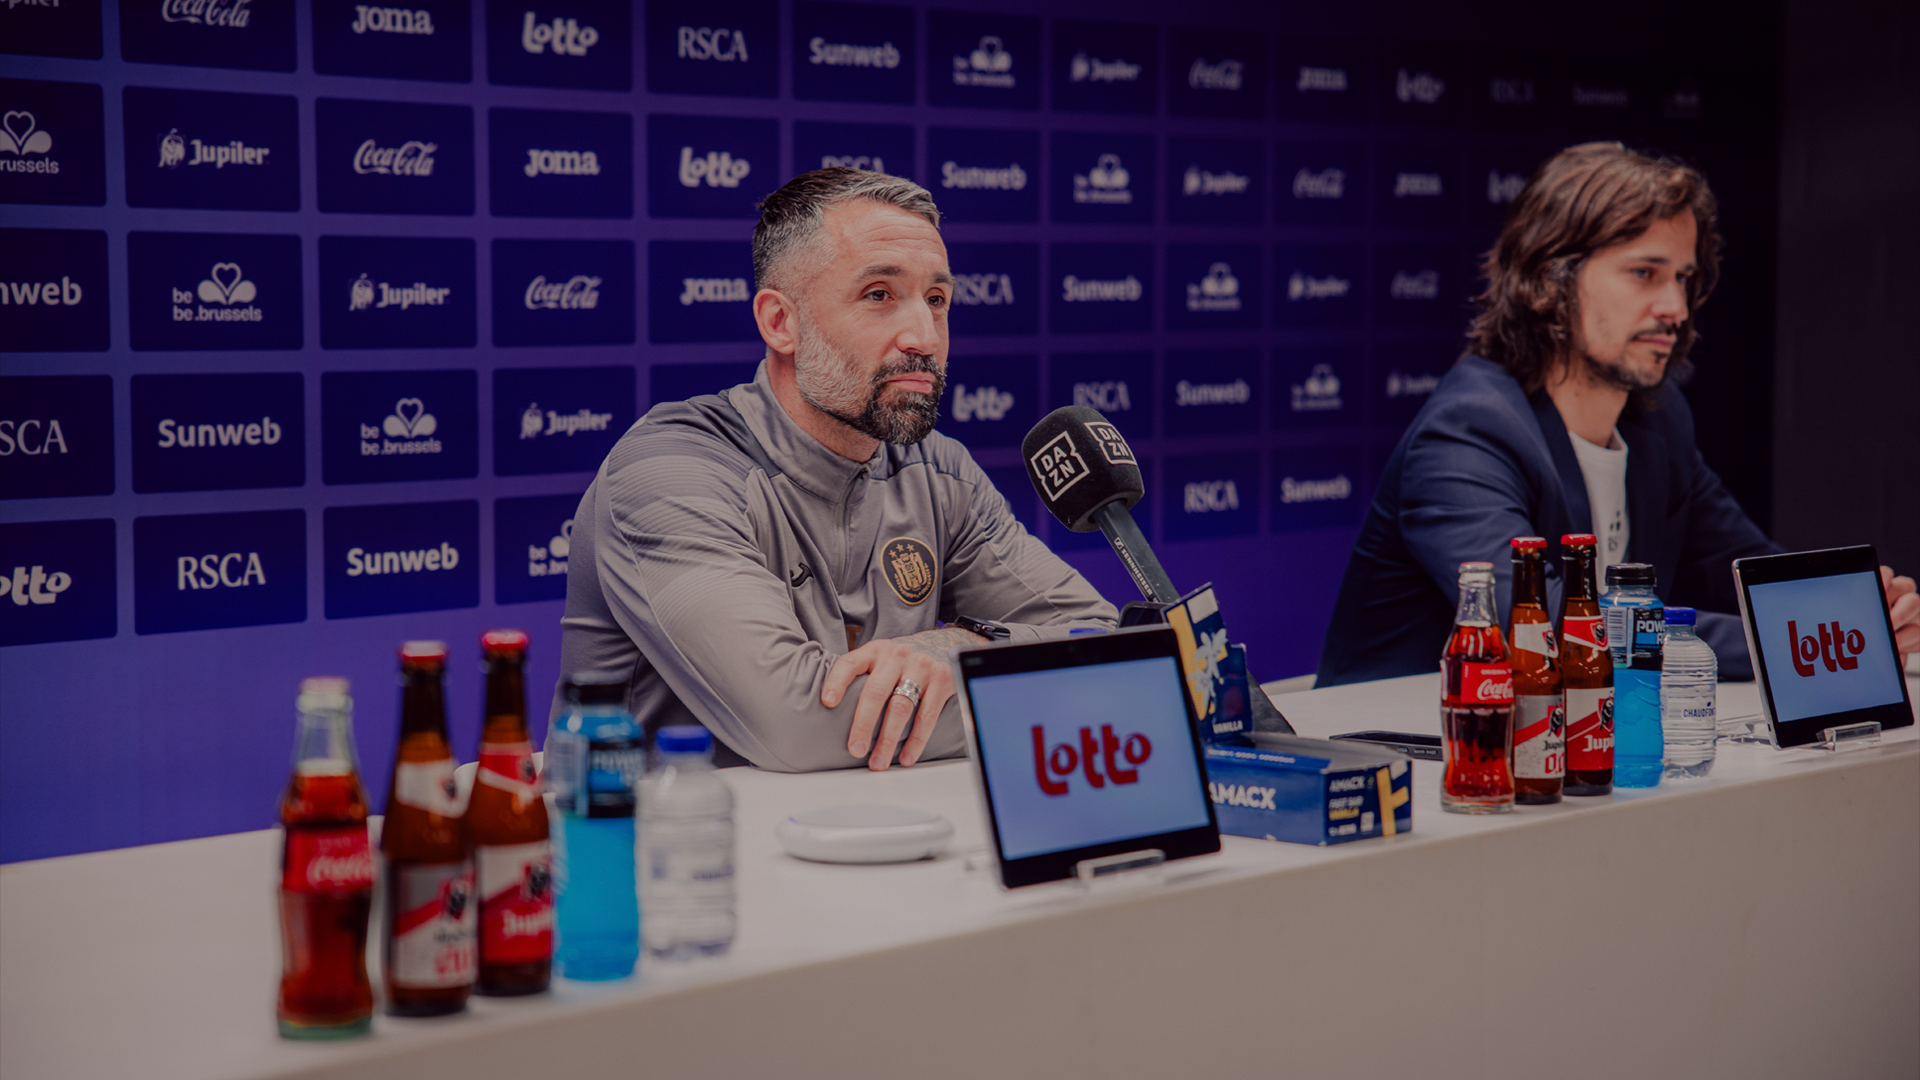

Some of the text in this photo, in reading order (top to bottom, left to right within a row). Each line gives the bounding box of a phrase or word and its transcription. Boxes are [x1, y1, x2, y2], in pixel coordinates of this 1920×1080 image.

[677, 26, 749, 62] RSCA
[809, 36, 900, 69] Sunweb
[0, 156, 60, 175] russels
[188, 138, 270, 169] Jupiler
[942, 161, 1027, 190] Sunweb
[172, 286, 194, 305] be
[374, 281, 451, 311] Jupiler
[172, 304, 263, 322] be.brussels
[158, 416, 282, 448] Sunweb
[360, 421, 380, 440] be
[545, 408, 613, 436] Jupiler
[0, 419, 68, 456] SCA
[360, 437, 443, 457] be.brussels
[1184, 481, 1239, 512] RSCA
[177, 551, 266, 591] RSCA
[346, 541, 459, 577] Sunweb
[1212, 719, 1244, 735] VANILLA
[1207, 781, 1277, 811] AMACX
